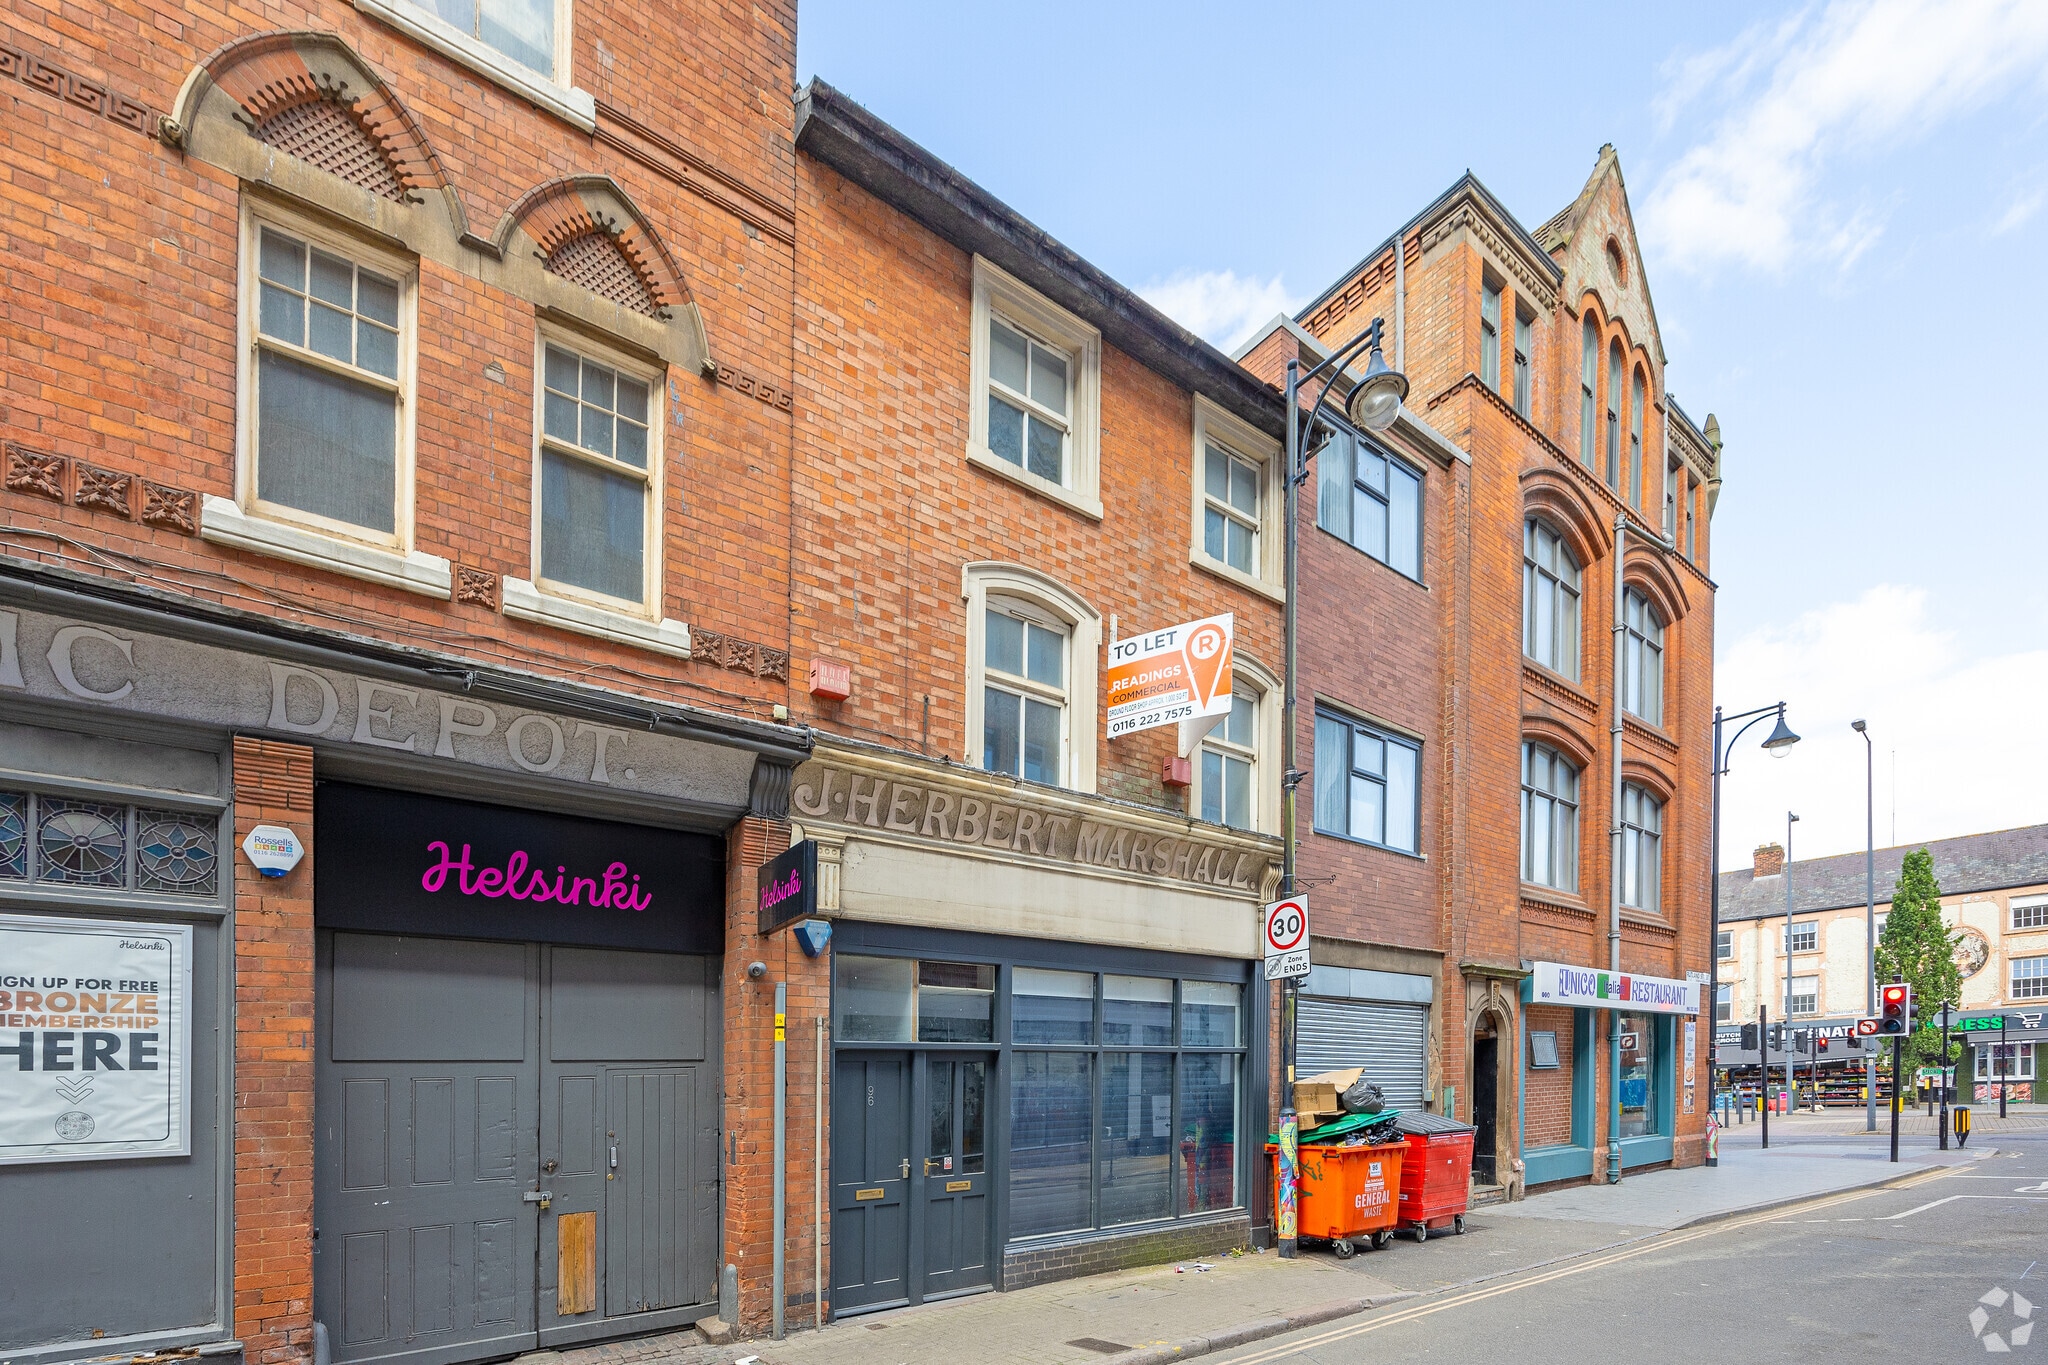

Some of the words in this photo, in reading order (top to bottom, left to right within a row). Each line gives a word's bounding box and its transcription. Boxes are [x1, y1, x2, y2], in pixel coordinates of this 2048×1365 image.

[1114, 641, 1138, 660] TO
[1144, 630, 1178, 652] LET
[1198, 635, 1214, 653] R
[1112, 664, 1182, 692] READINGS
[1112, 680, 1181, 704] COMMERCIAL
[1112, 718, 1136, 733] 0116
[1140, 712, 1160, 726] 222
[1164, 705, 1192, 720] 7575
[254, 835, 293, 847] Rossells
[421, 840, 652, 911] Helsinki
[759, 868, 802, 912] Helsinki
[1273, 914, 1300, 938] 30
[119, 939, 165, 951] Helsinki
[1283, 962, 1308, 974] ENDS
[1287, 955, 1303, 963] Zone
[42, 976, 69, 990] UP
[75, 977, 113, 991] FOR
[119, 980, 158, 992] FREE
[1603, 980, 1625, 996] Italian
[1631, 980, 1688, 1006] RESTAURANT
[0, 1031, 159, 1072] HERE
[1355, 1189, 1391, 1209] GENERAL
[1363, 1204, 1383, 1219] WASTE
